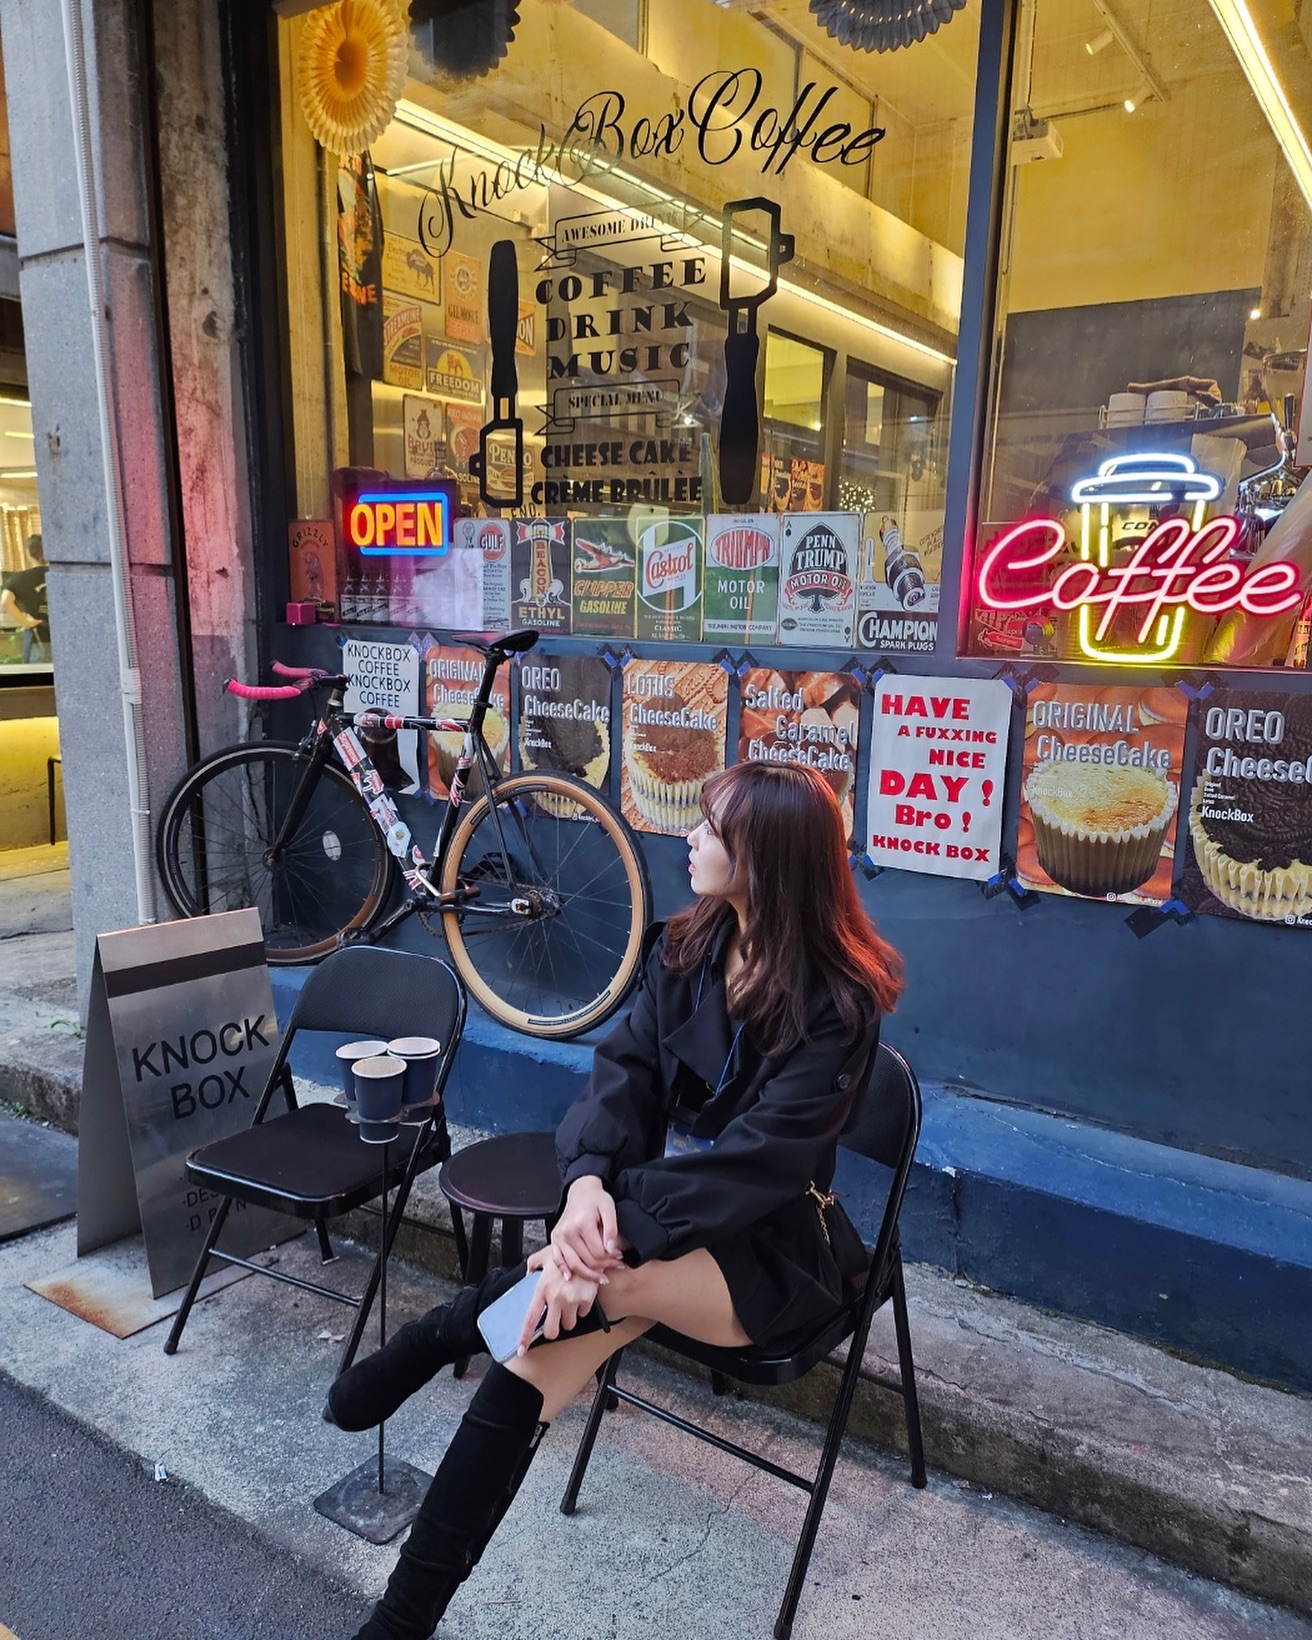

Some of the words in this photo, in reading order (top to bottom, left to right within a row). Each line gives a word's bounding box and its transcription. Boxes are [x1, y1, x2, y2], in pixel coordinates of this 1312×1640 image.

[418, 122, 561, 258] Knock
[559, 91, 685, 187] Box
[688, 68, 886, 173] Coffee
[561, 221, 626, 243] AWESOME
[535, 257, 707, 305] COFFEE
[545, 300, 694, 343] DRINK
[546, 342, 690, 379] MUSIC
[430, 372, 480, 394] FREEDOM
[568, 393, 622, 409] SPECIAL
[626, 390, 664, 405] MENU
[541, 442, 623, 468] CHEESE
[629, 440, 692, 465] CAKE
[531, 475, 604, 505] CRÈME
[292, 526, 329, 548] GRIZZLY
[351, 502, 443, 547] OPEN
[480, 534, 505, 550] GULF
[716, 529, 771, 568] TRIUMPH
[805, 534, 836, 550] PENN
[535, 541, 547, 596] BEACON
[646, 542, 693, 589] Castrol
[796, 550, 845, 570] TRUMP
[574, 579, 634, 599] CLIPPER
[717, 580, 765, 594] MOTOR
[790, 573, 828, 590] MOTOR
[831, 575, 847, 591] OIL
[979, 517, 1301, 644] Coffee
[518, 605, 566, 620] ETHYL
[580, 600, 628, 615] GASOLINE
[730, 595, 751, 610] OIL
[522, 618, 560, 628] GASOLINE
[748, 624, 773, 632] COMPANY
[859, 611, 939, 648] CHAMPION
[347, 644, 411, 663] KNOCKBOX
[879, 639, 906, 650] SPARK
[908, 640, 934, 651] PLUGS
[358, 659, 399, 677] COFFEE
[521, 665, 562, 692] OREO
[347, 674, 411, 693] KNOCKBOX
[627, 673, 677, 699] LOTUS
[359, 690, 400, 708] COFFEE
[524, 694, 610, 724] CheeseCake
[745, 684, 804, 711] Salted
[881, 693, 971, 721] HAVE
[630, 702, 718, 731] CheeseCake
[1032, 700, 1140, 736] ORIGINAL
[1205, 706, 1286, 746] OREO
[776, 715, 856, 746] Caramel
[897, 725, 911, 737] A
[915, 726, 998, 745] FUXXING
[748, 739, 851, 772] CheeseCake
[928, 748, 986, 769] NICE
[1037, 734, 1172, 770] CheeseCake
[879, 769, 969, 803] DAY
[895, 804, 952, 831] Bro
[1202, 805, 1254, 823] KnockBox
[872, 834, 941, 857] KNOCK
[946, 844, 991, 864] BOX
[132, 1014, 270, 1083] KNOCK
[170, 1065, 250, 1121] BOX
